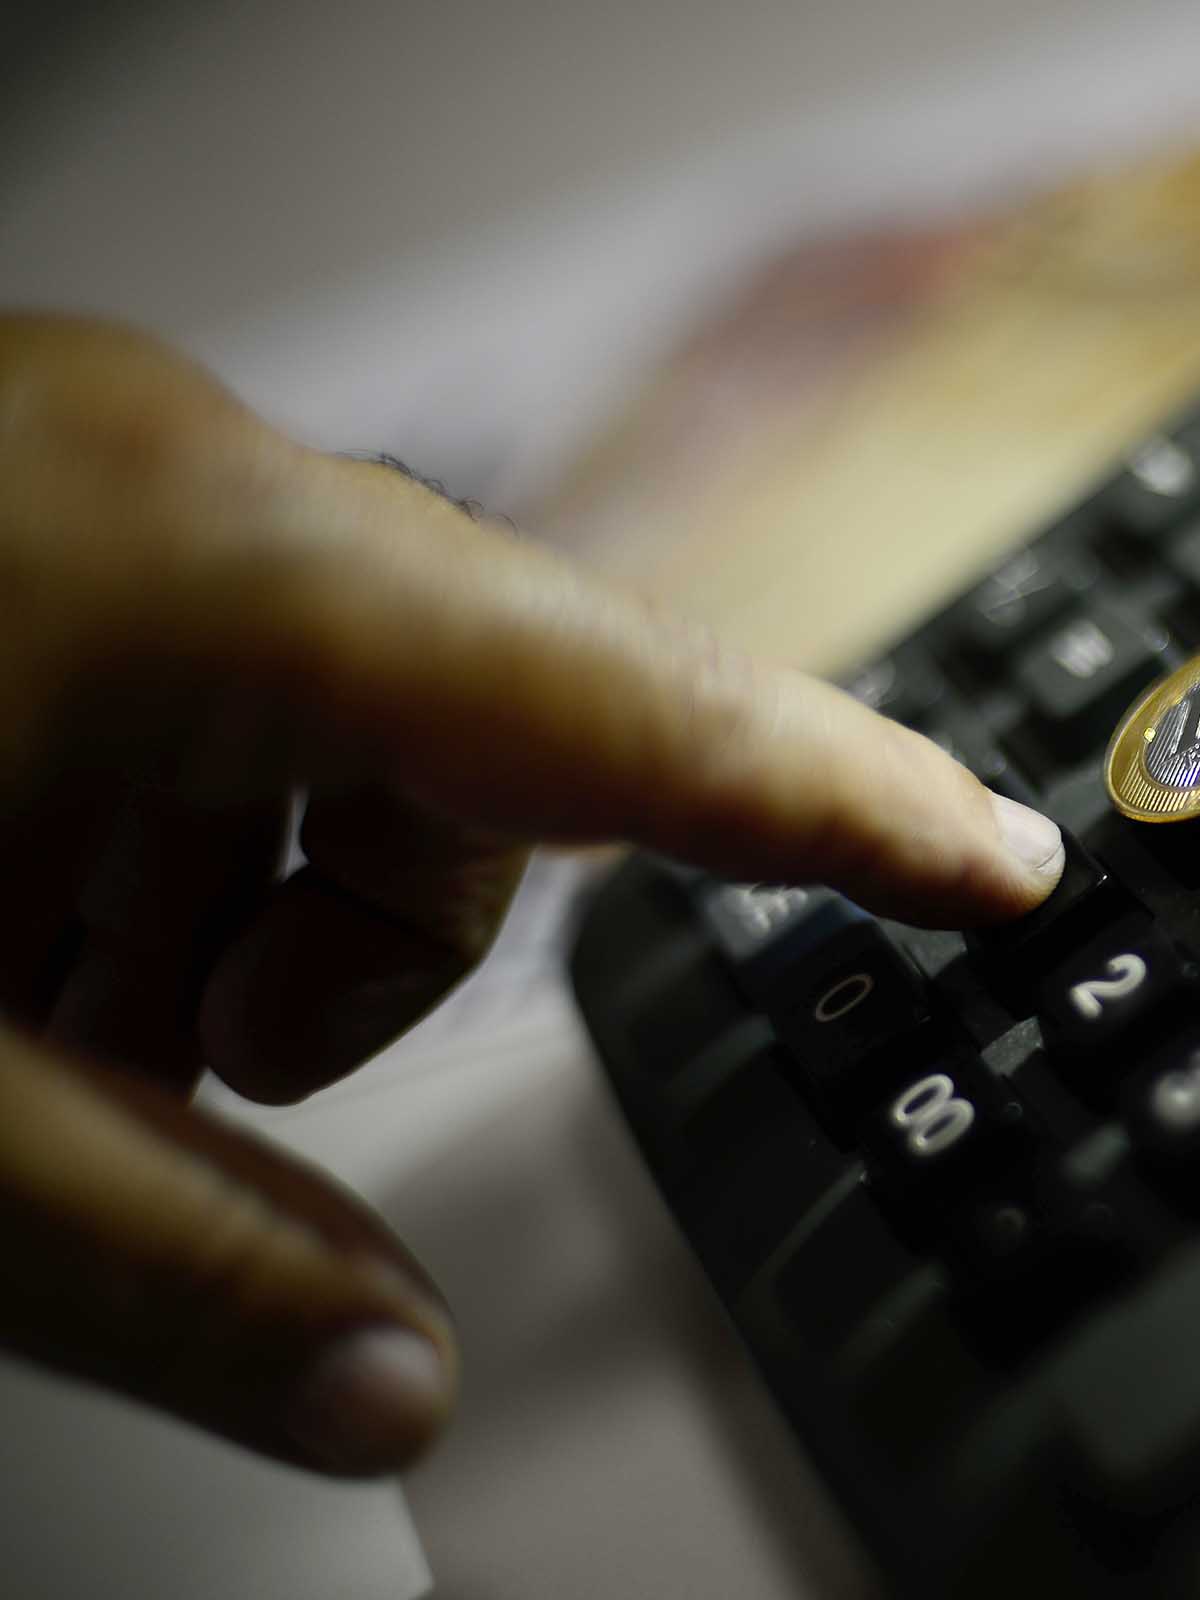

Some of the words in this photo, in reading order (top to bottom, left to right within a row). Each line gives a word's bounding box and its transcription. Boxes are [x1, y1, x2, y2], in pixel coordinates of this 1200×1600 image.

[815, 972, 874, 1023] 0
[1071, 953, 1147, 1019] 2
[892, 1073, 975, 1155] 00
